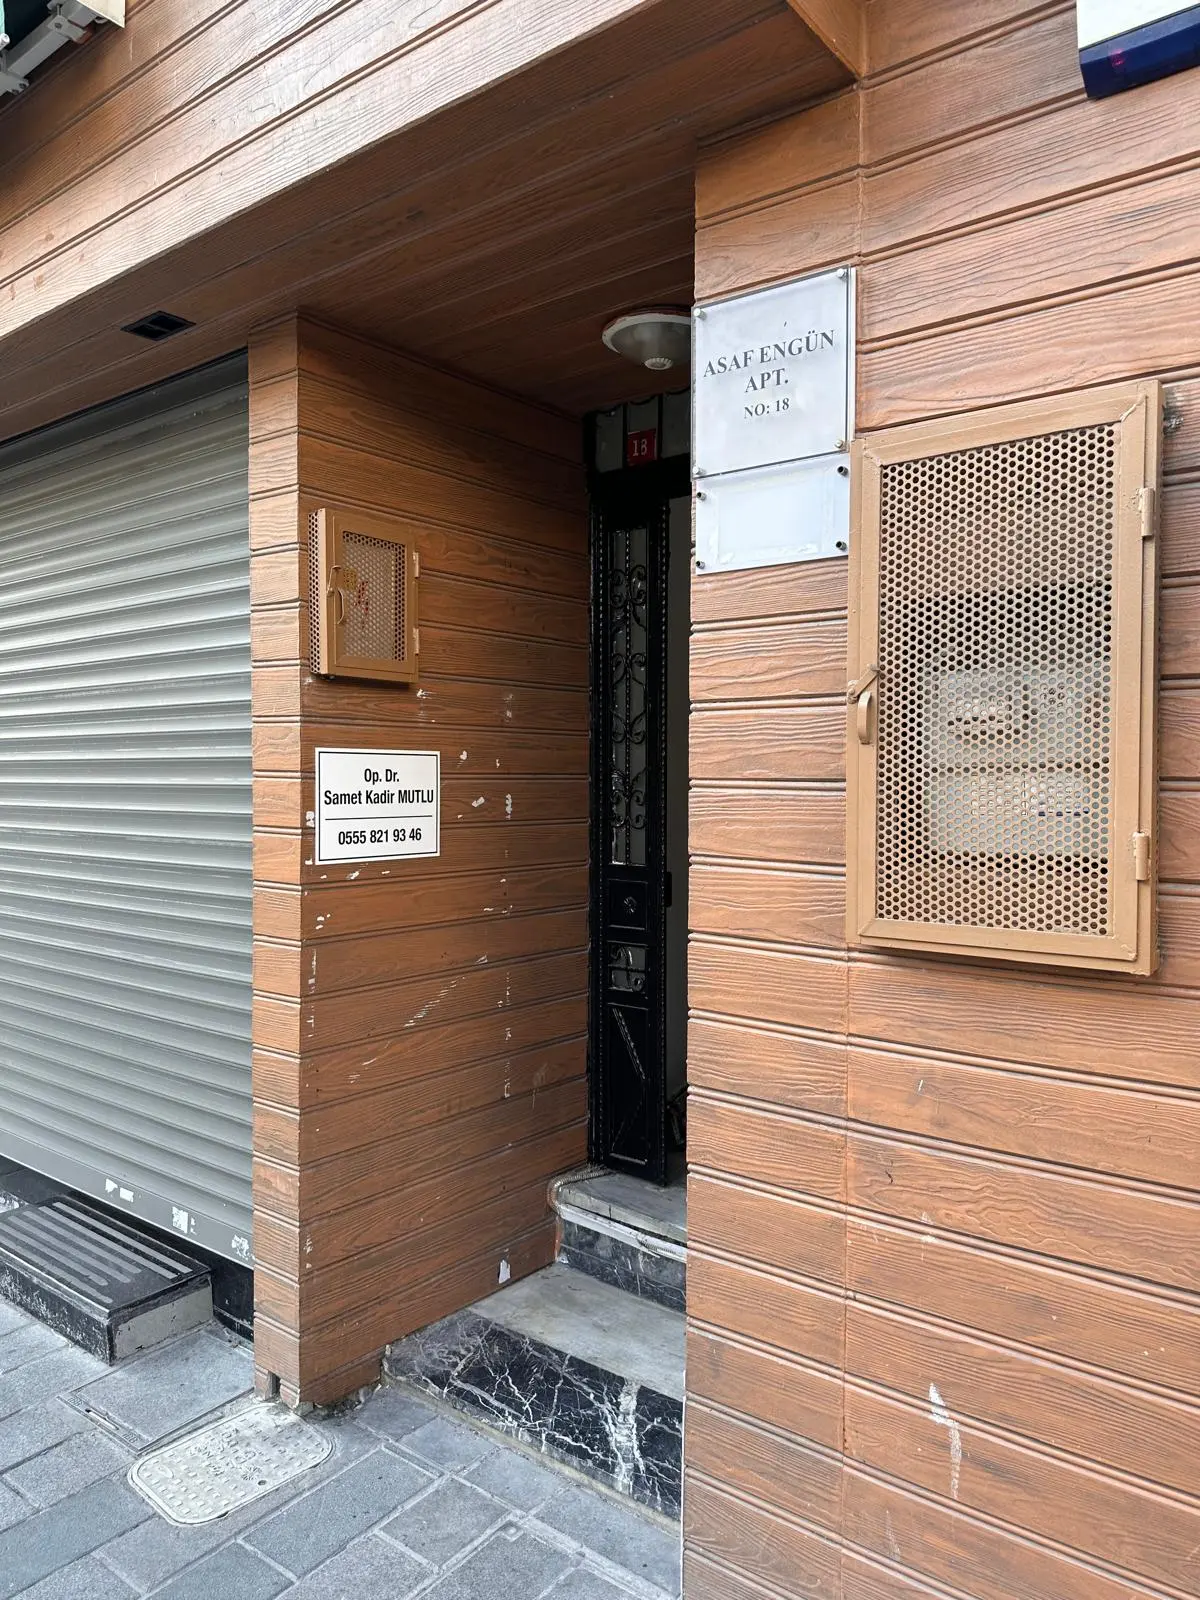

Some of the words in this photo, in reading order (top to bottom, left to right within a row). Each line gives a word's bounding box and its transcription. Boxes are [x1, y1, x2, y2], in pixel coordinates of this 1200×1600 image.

[703, 349, 755, 377] ASAF
[759, 329, 835, 364] ENGÜN
[745, 368, 789, 393] APT.
[743, 401, 770, 419] NO:
[776, 397, 790, 412] 18
[364, 768, 382, 785] Op.
[385, 768, 400, 782] Dr.
[324, 790, 362, 805] Samet
[365, 789, 395, 804] Kadir
[398, 789, 434, 804] MUTLU
[338, 831, 367, 845] 0555
[369, 829, 389, 843] 821
[393, 828, 406, 842] 93
[408, 828, 422, 841] 46
